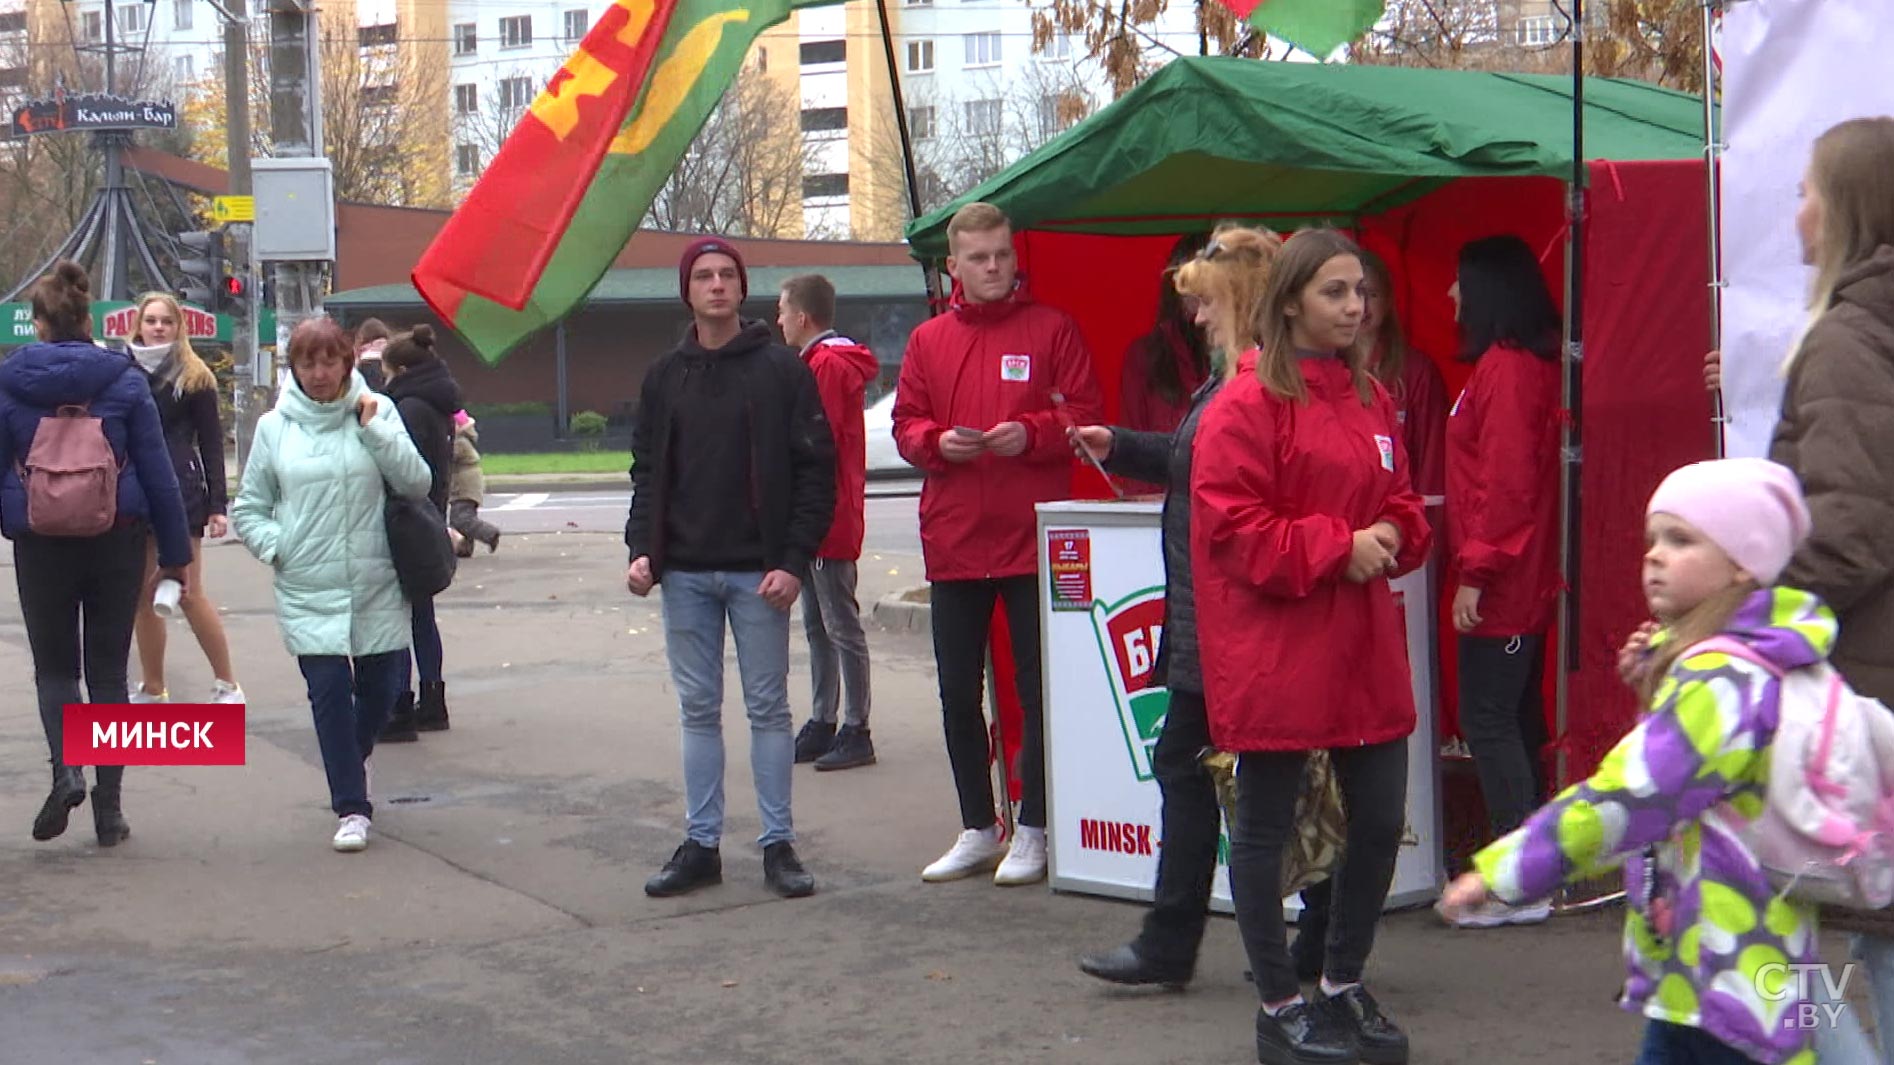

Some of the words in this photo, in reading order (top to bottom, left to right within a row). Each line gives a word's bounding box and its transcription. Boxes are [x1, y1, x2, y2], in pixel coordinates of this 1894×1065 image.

[14, 309, 33, 321] ЛУ
[14, 324, 37, 336] ПИ
[1080, 818, 1151, 856] MINSK
